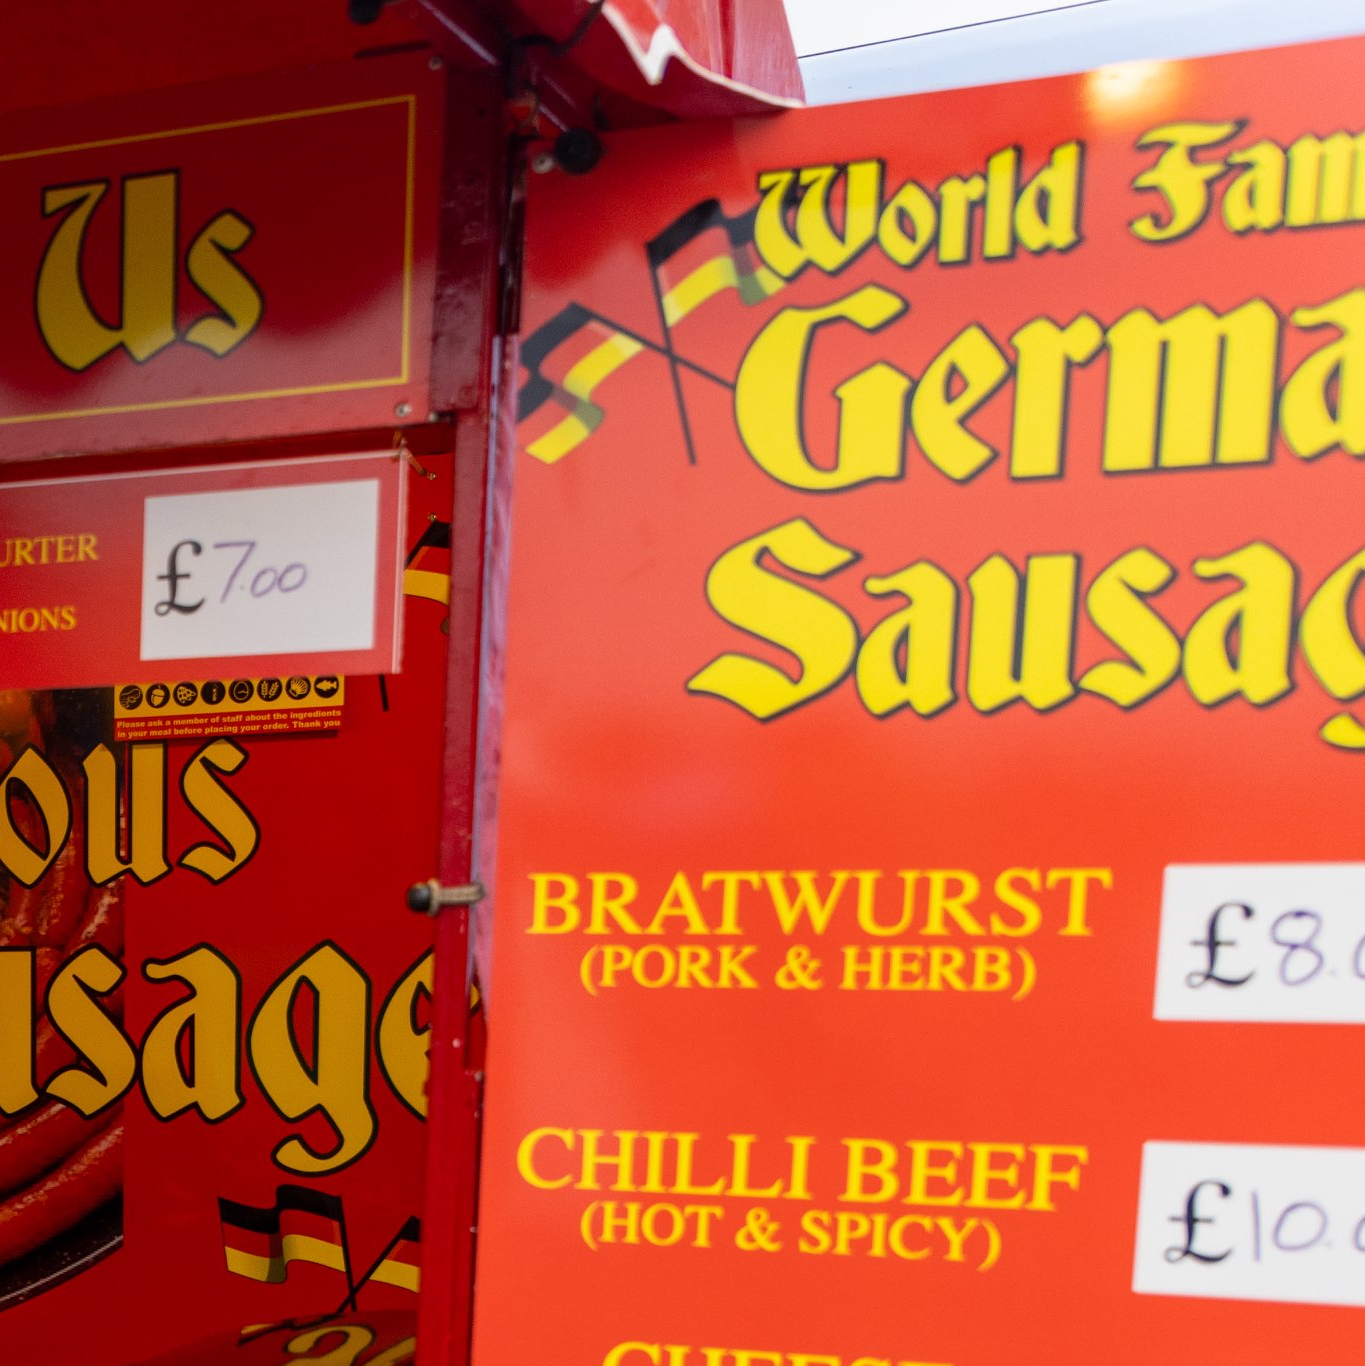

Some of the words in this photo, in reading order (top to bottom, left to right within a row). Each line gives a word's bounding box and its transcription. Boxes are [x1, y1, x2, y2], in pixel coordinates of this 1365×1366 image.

[752, 140, 1086, 281] World
[35, 168, 263, 373] Us
[153, 540, 310, 616] £7.00
[117, 721, 146, 729] Please
[147, 719, 164, 727] ask
[173, 717, 208, 725] member
[210, 715, 220, 723] of
[222, 714, 243, 723] staff
[245, 713, 270, 721] about
[272, 712, 288, 720] the
[290, 709, 341, 720] ingredients
[128, 731, 148, 739] your
[173, 727, 203, 735] before
[204, 725, 238, 735] placing
[240, 724, 260, 733] your
[262, 722, 289, 731] order.
[291, 720, 321, 729] Thank
[323, 720, 341, 729] you
[525, 867, 1112, 938] BRATWURST
[579, 943, 759, 997] (PORK
[775, 945, 823, 991] &
[840, 945, 1038, 1003] HERB)
[1185, 900, 1365, 990] £8.
[516, 1126, 815, 1200] CHILLI
[838, 1138, 1088, 1212] BEEF
[580, 1203, 722, 1253] (HOT
[735, 1208, 782, 1253] &
[799, 1210, 1002, 1272] SPICY)
[1163, 1179, 1365, 1266] £10.
